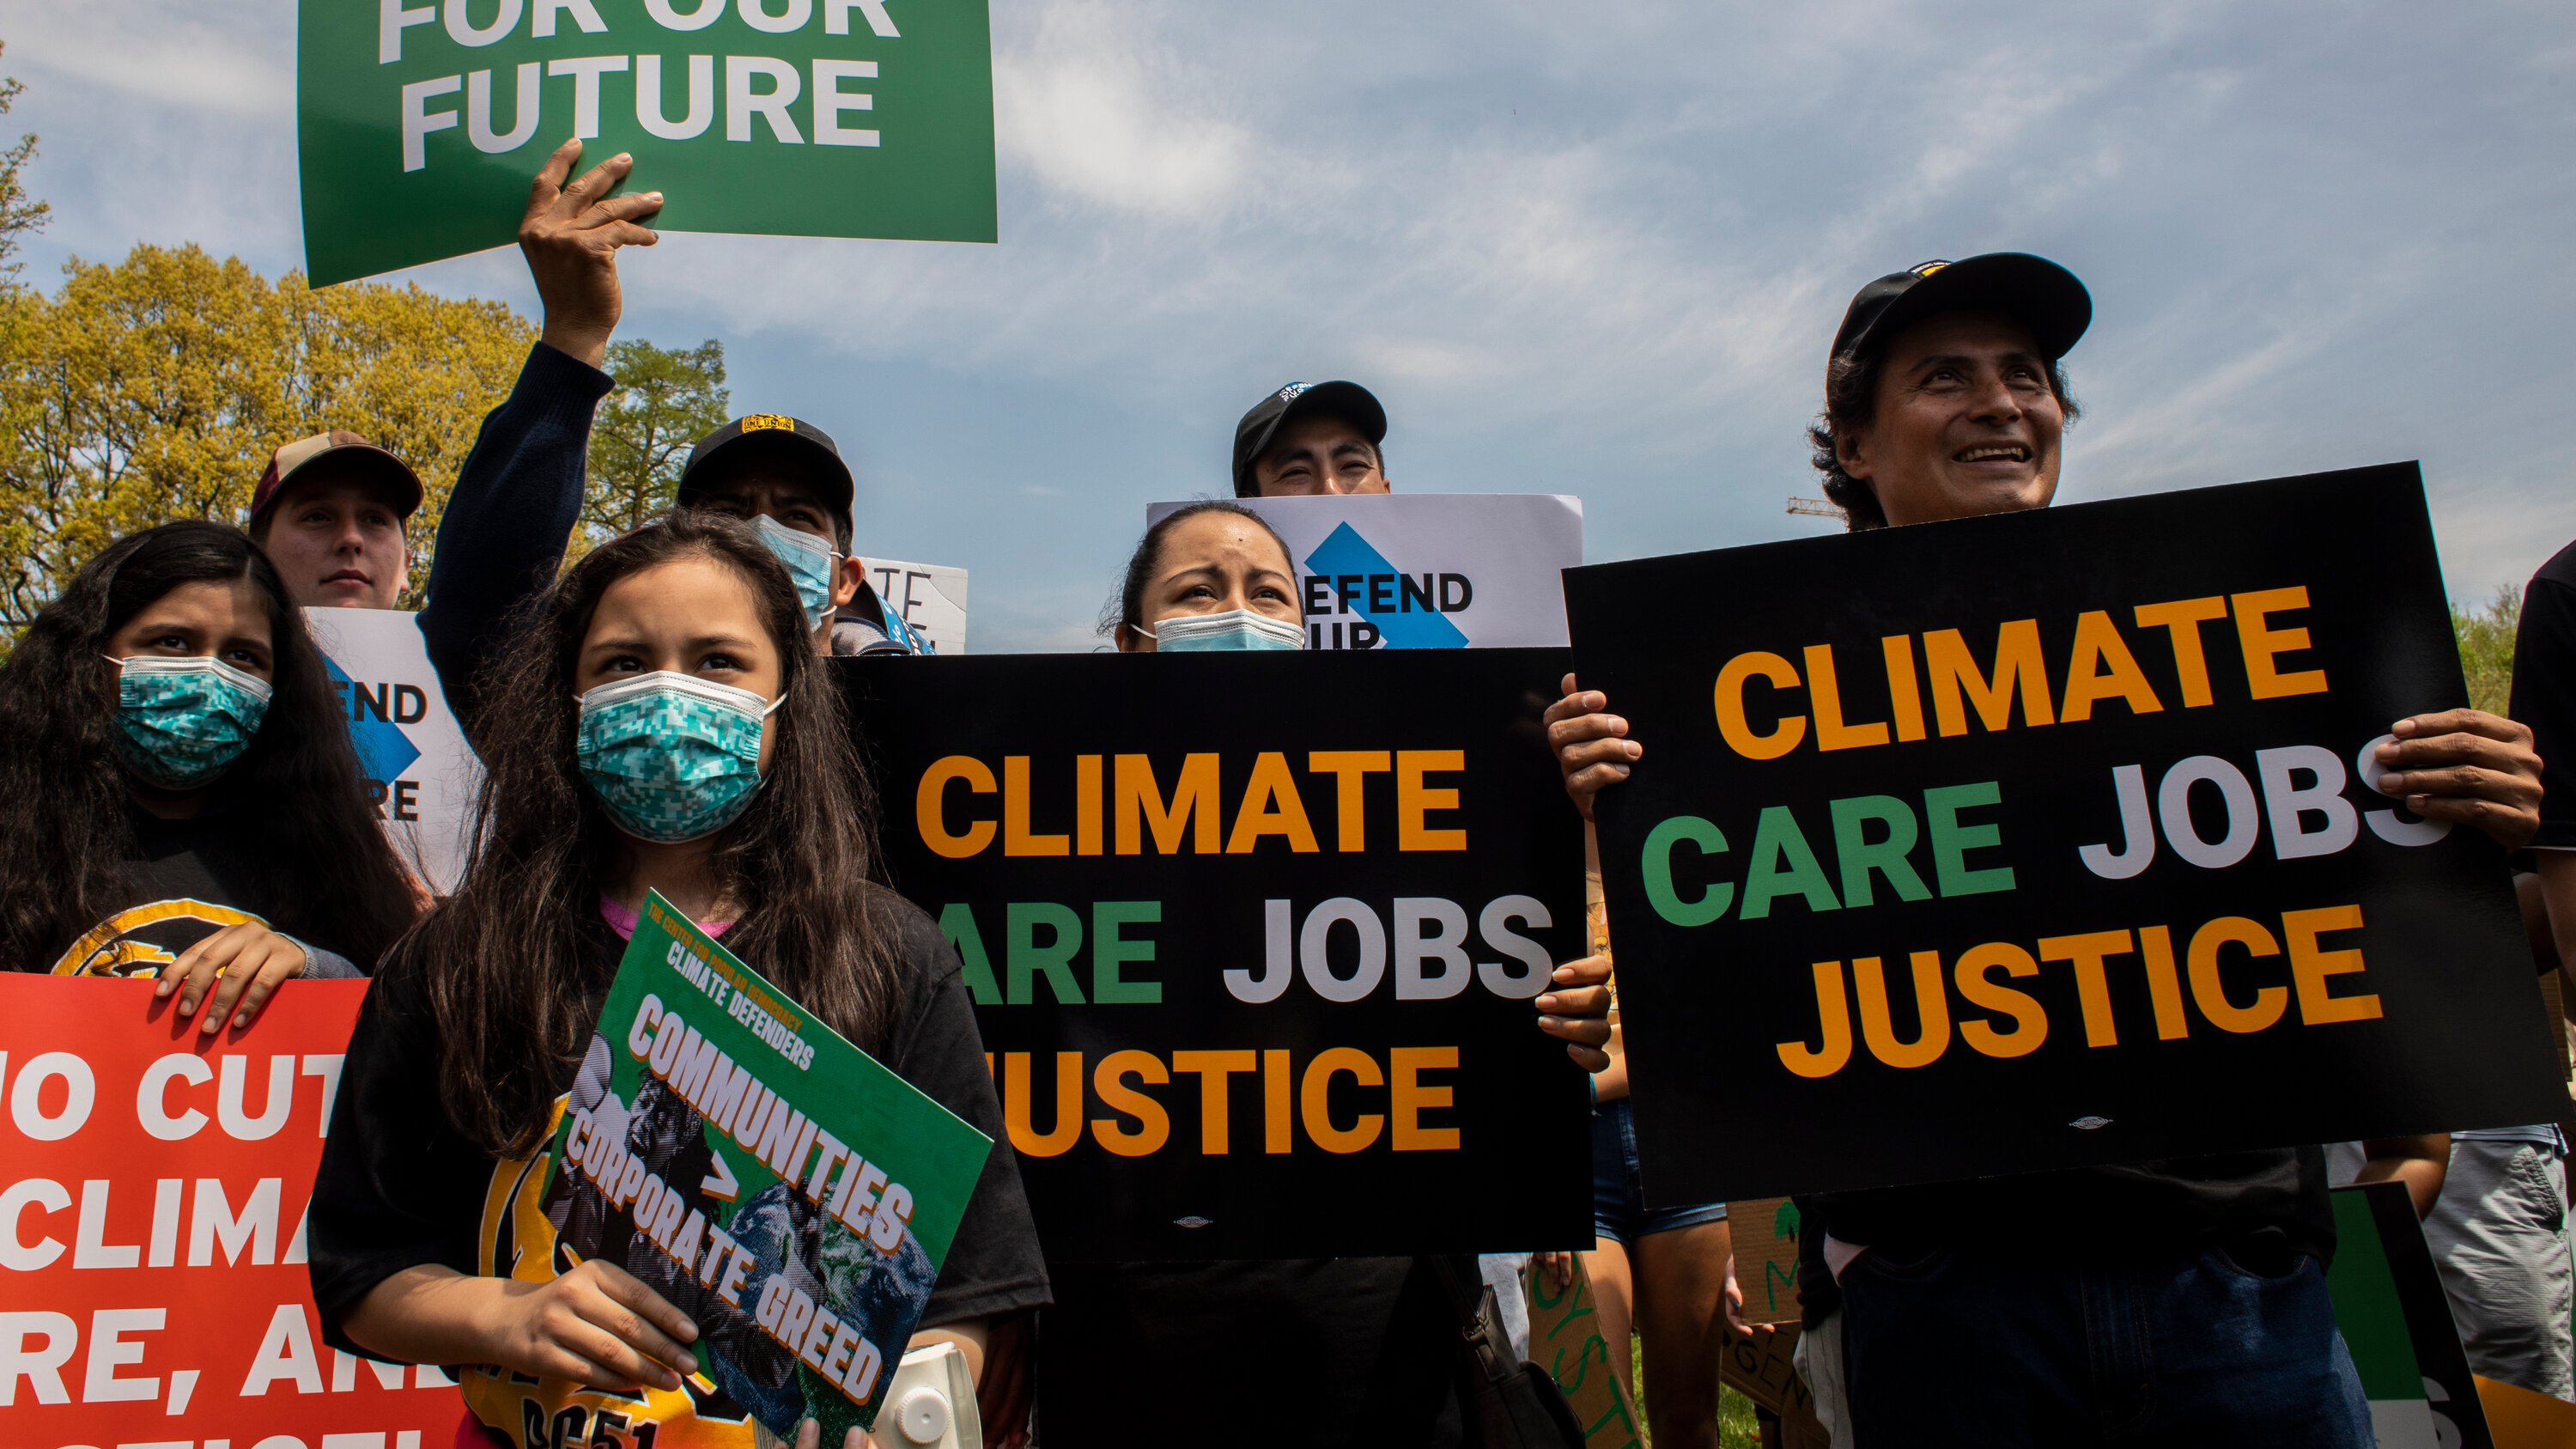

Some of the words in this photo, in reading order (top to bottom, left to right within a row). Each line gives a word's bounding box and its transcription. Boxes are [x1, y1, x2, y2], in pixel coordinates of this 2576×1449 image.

[402, 54, 880, 173] FUTURE
[874, 568, 932, 630] TE
[1303, 573, 1473, 615] EFEND
[1310, 621, 1380, 650] UR
[1715, 585, 2329, 760] CLIMATE
[361, 778, 420, 822] RE
[915, 749, 1467, 859] CLIMATE
[1641, 781, 2016, 927] CARE
[648, 901, 665, 923] THE
[663, 915, 694, 949] CENTER
[692, 941, 710, 962] FOR
[708, 953, 747, 993] POPULAR
[746, 983, 803, 1033] DEMOCRACY
[666, 941, 730, 1007] CLIMATE
[727, 989, 815, 1071] DEFENDERS
[938, 900, 1163, 1005] ARE
[1223, 894, 1553, 1004] JOBS
[1776, 904, 2383, 1079] JUSTICE
[0, 1050, 95, 1142] O
[629, 993, 914, 1256] COMMUNITIES
[984, 1046, 1461, 1158] USTICE
[566, 1107, 756, 1310] CORPORATE
[753, 1273, 882, 1406] GREED
